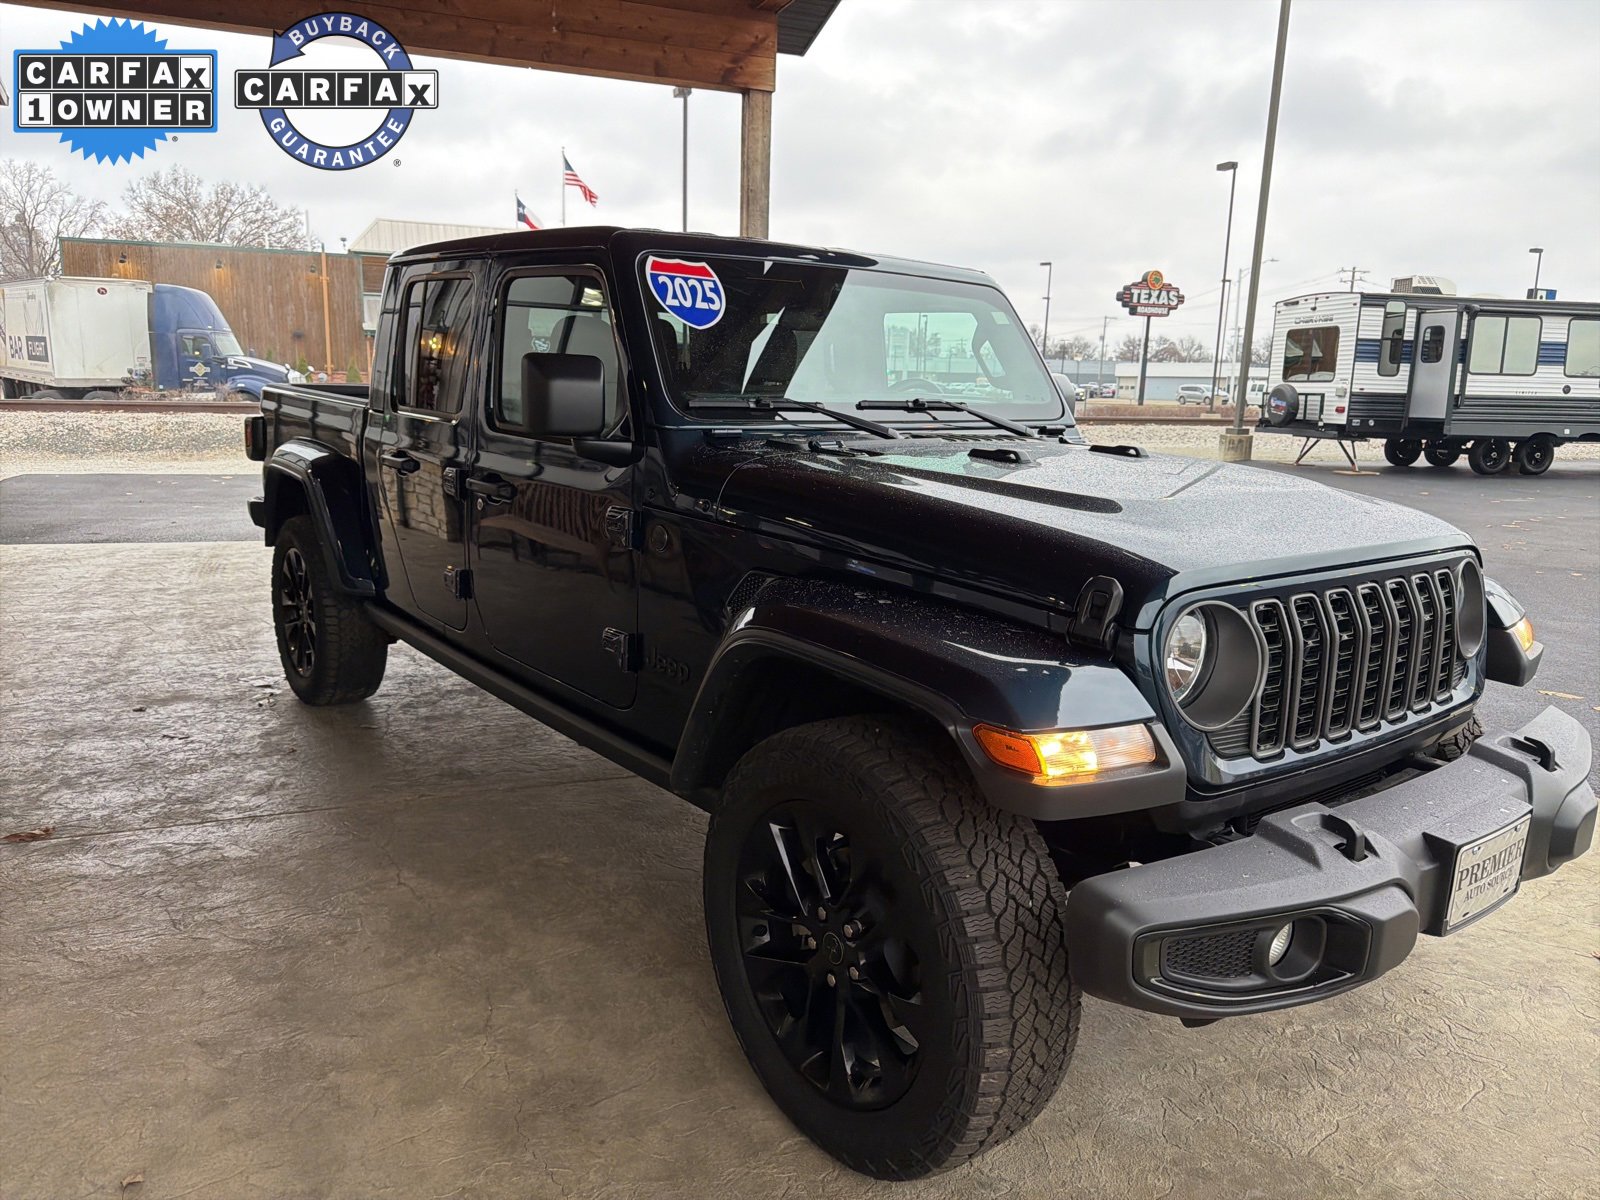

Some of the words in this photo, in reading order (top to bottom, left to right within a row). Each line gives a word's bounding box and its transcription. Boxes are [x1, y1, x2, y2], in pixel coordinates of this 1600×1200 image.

[658, 275, 721, 310] 2025
[1131, 288, 1178, 305] TEXAS
[9, 336, 24, 360] BAR
[1455, 838, 1524, 891] PREMIER
